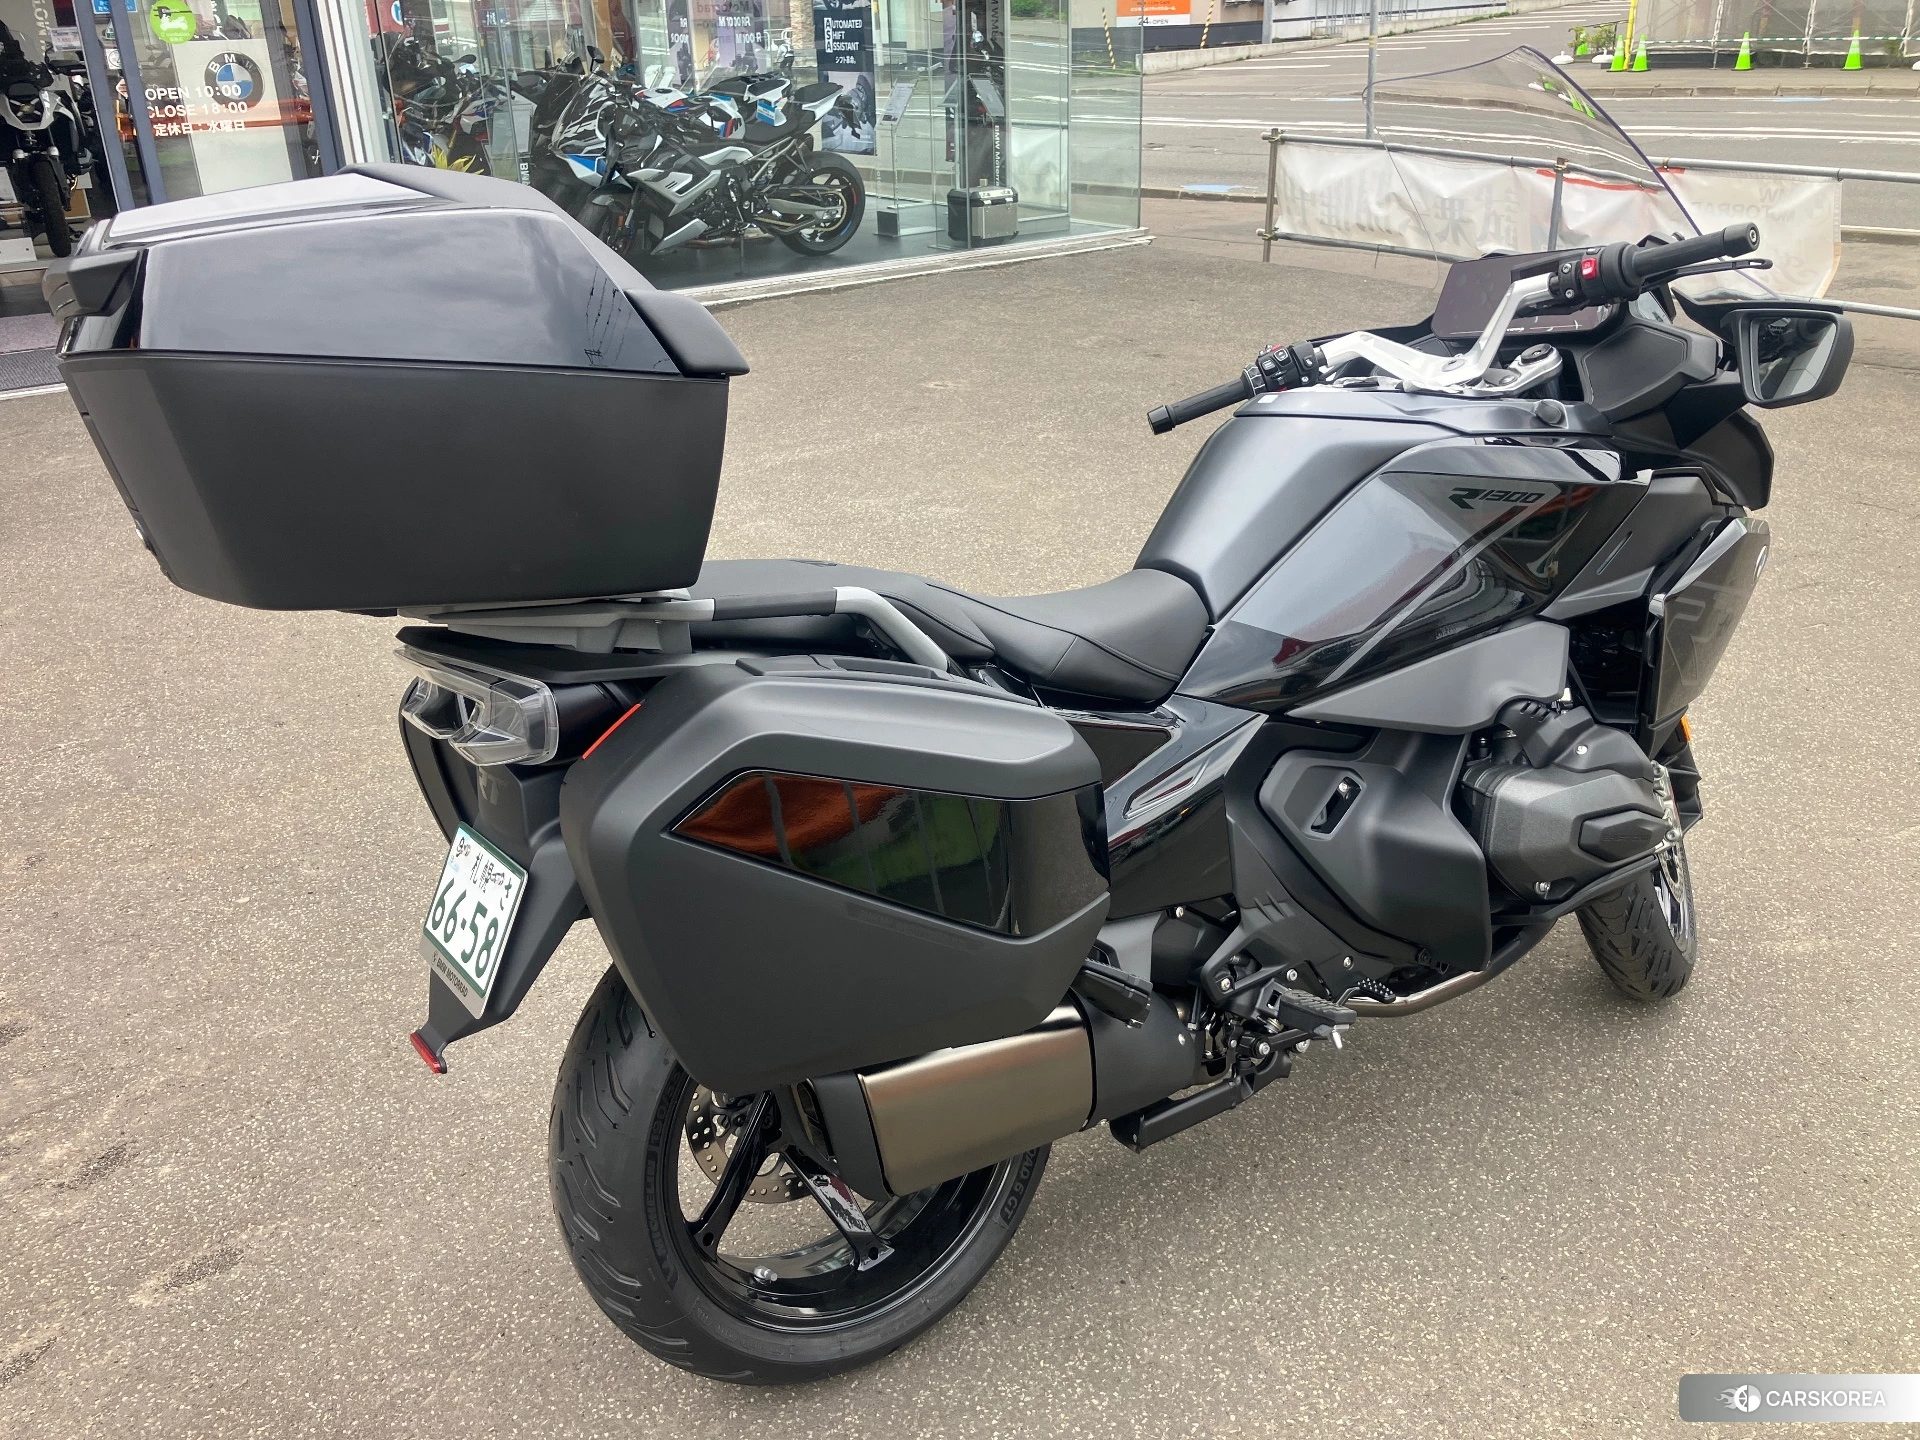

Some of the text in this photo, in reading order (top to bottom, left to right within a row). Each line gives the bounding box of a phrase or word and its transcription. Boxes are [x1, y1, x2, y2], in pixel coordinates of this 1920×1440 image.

[824, 18, 862, 29] AUTOMATED
[825, 29, 846, 40] SHIFT
[826, 41, 860, 53] ASSISTANT
[145, 84, 242, 100] OPEN 10:00
[147, 101, 248, 118] CLOSE 18:00
[645, 1159, 669, 1257] MICHELIN
[1004, 1196, 1018, 1220] GT
